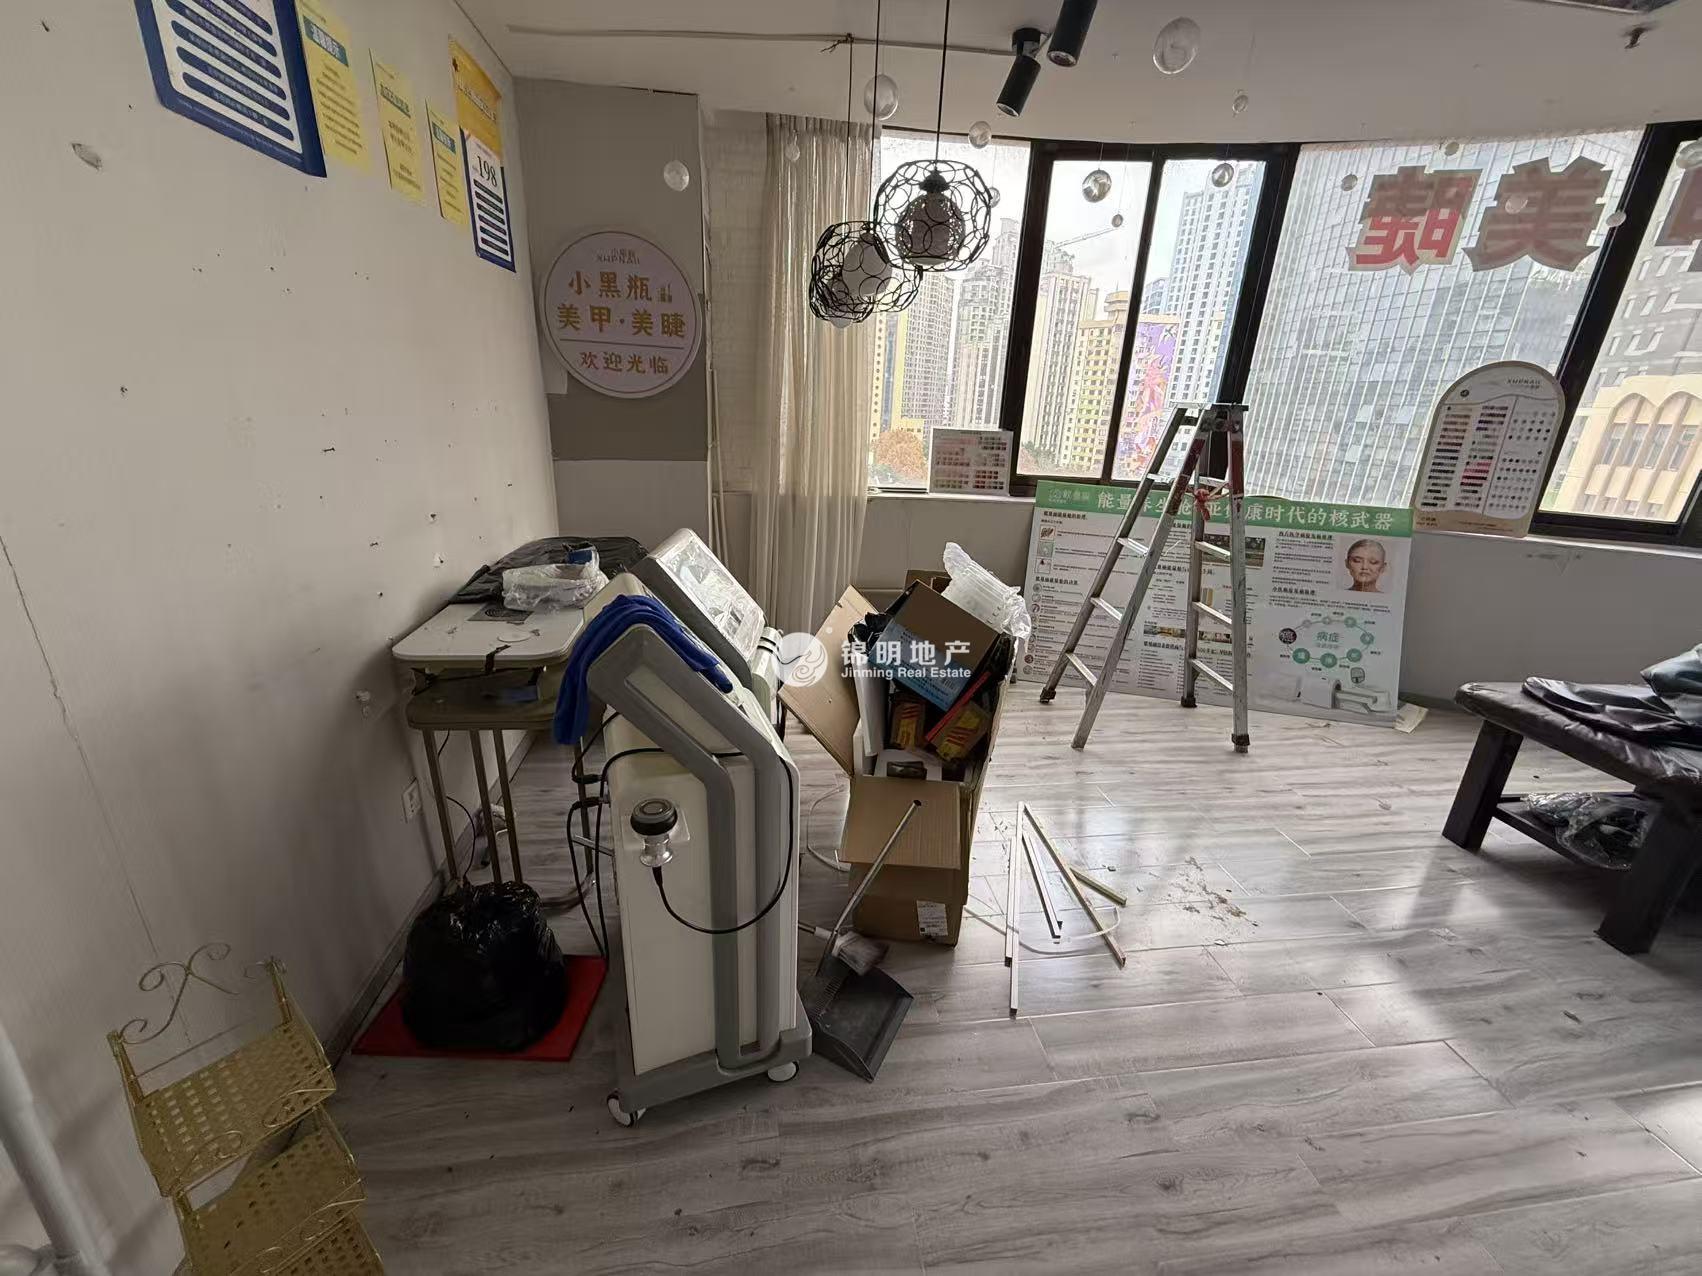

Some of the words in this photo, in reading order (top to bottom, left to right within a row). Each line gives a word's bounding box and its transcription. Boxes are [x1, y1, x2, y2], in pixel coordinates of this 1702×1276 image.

[477, 155, 498, 187] 198
[568, 270, 653, 301] 小黑瓶
[580, 351, 670, 375] 欢迎光临
